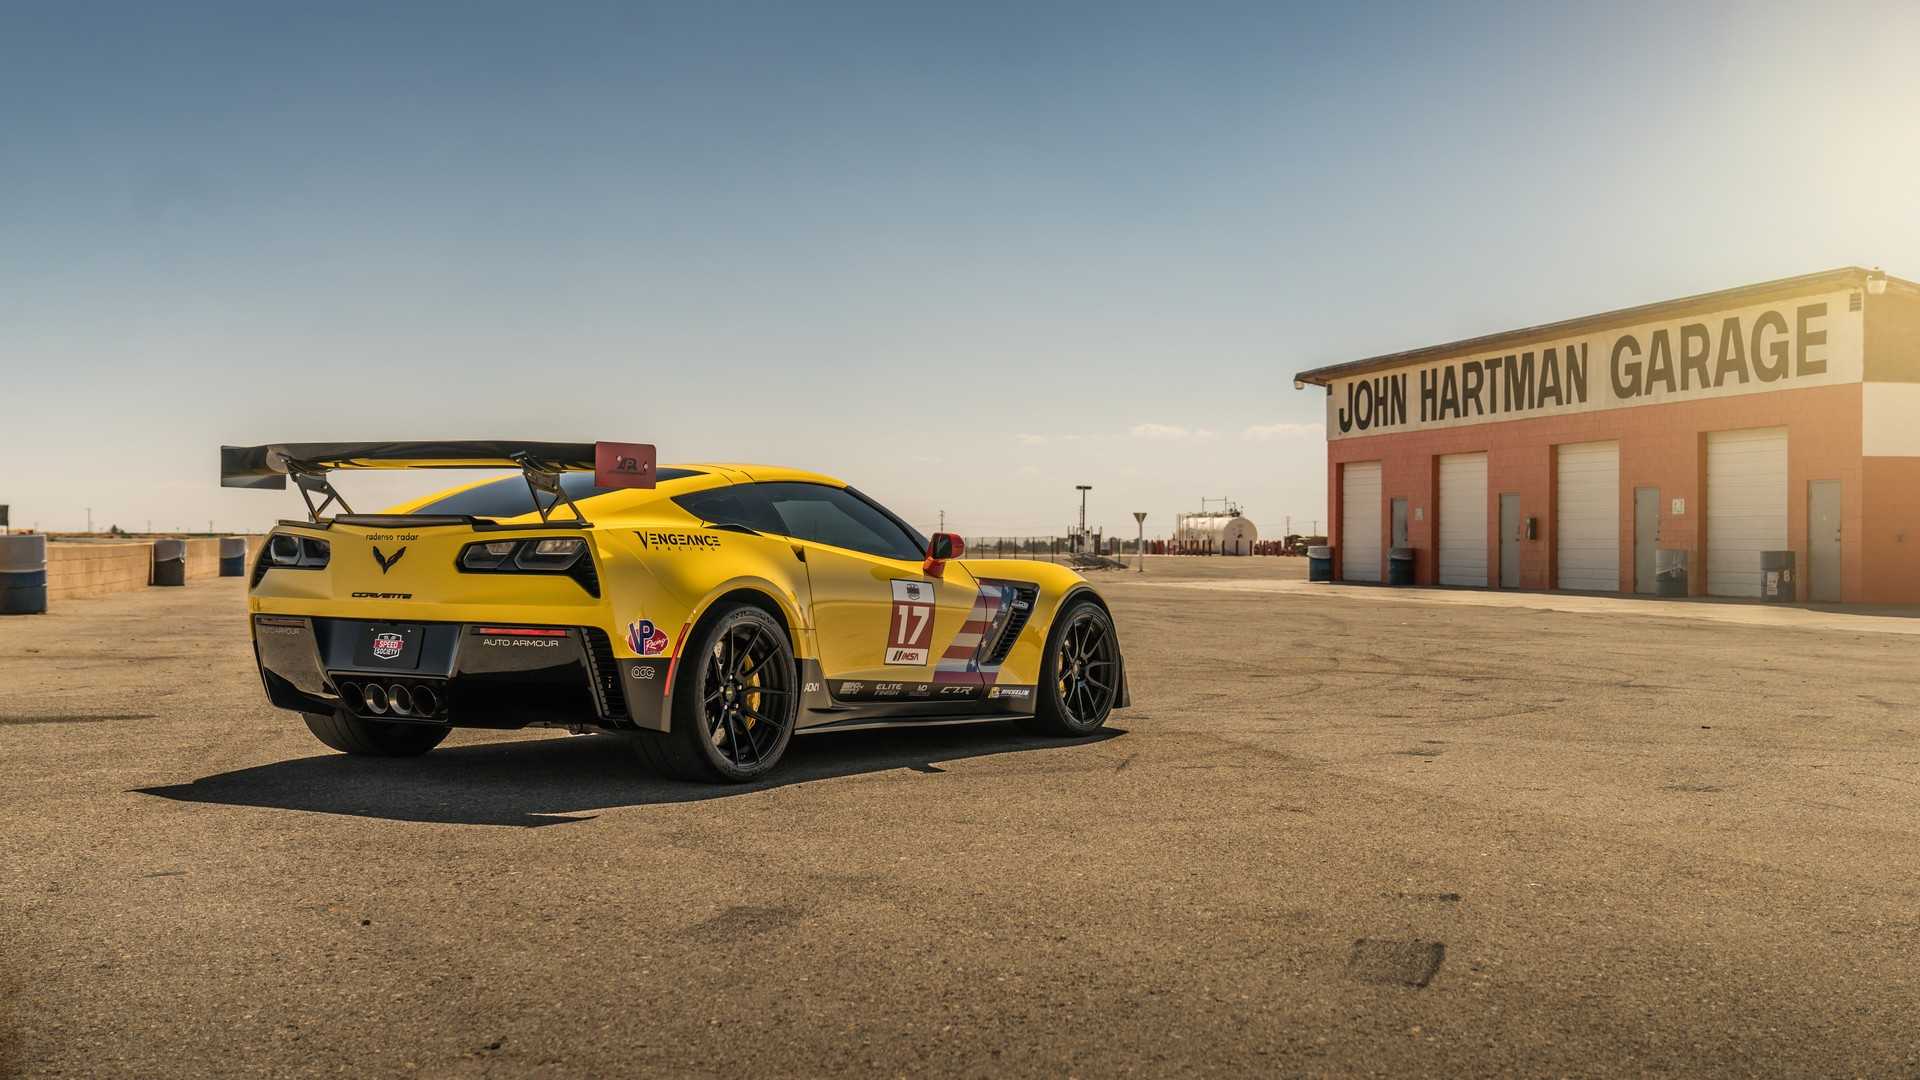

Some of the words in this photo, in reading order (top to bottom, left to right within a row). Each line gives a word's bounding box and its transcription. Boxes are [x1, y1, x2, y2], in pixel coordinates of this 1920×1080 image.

[1339, 373, 1407, 433] JOHN
[1420, 342, 1588, 422] HARTMAN
[1610, 302, 1828, 399] GARAGE
[632, 531, 721, 550] VENGEANCE
[897, 604, 930, 645] 17
[379, 640, 398, 648] SPEED
